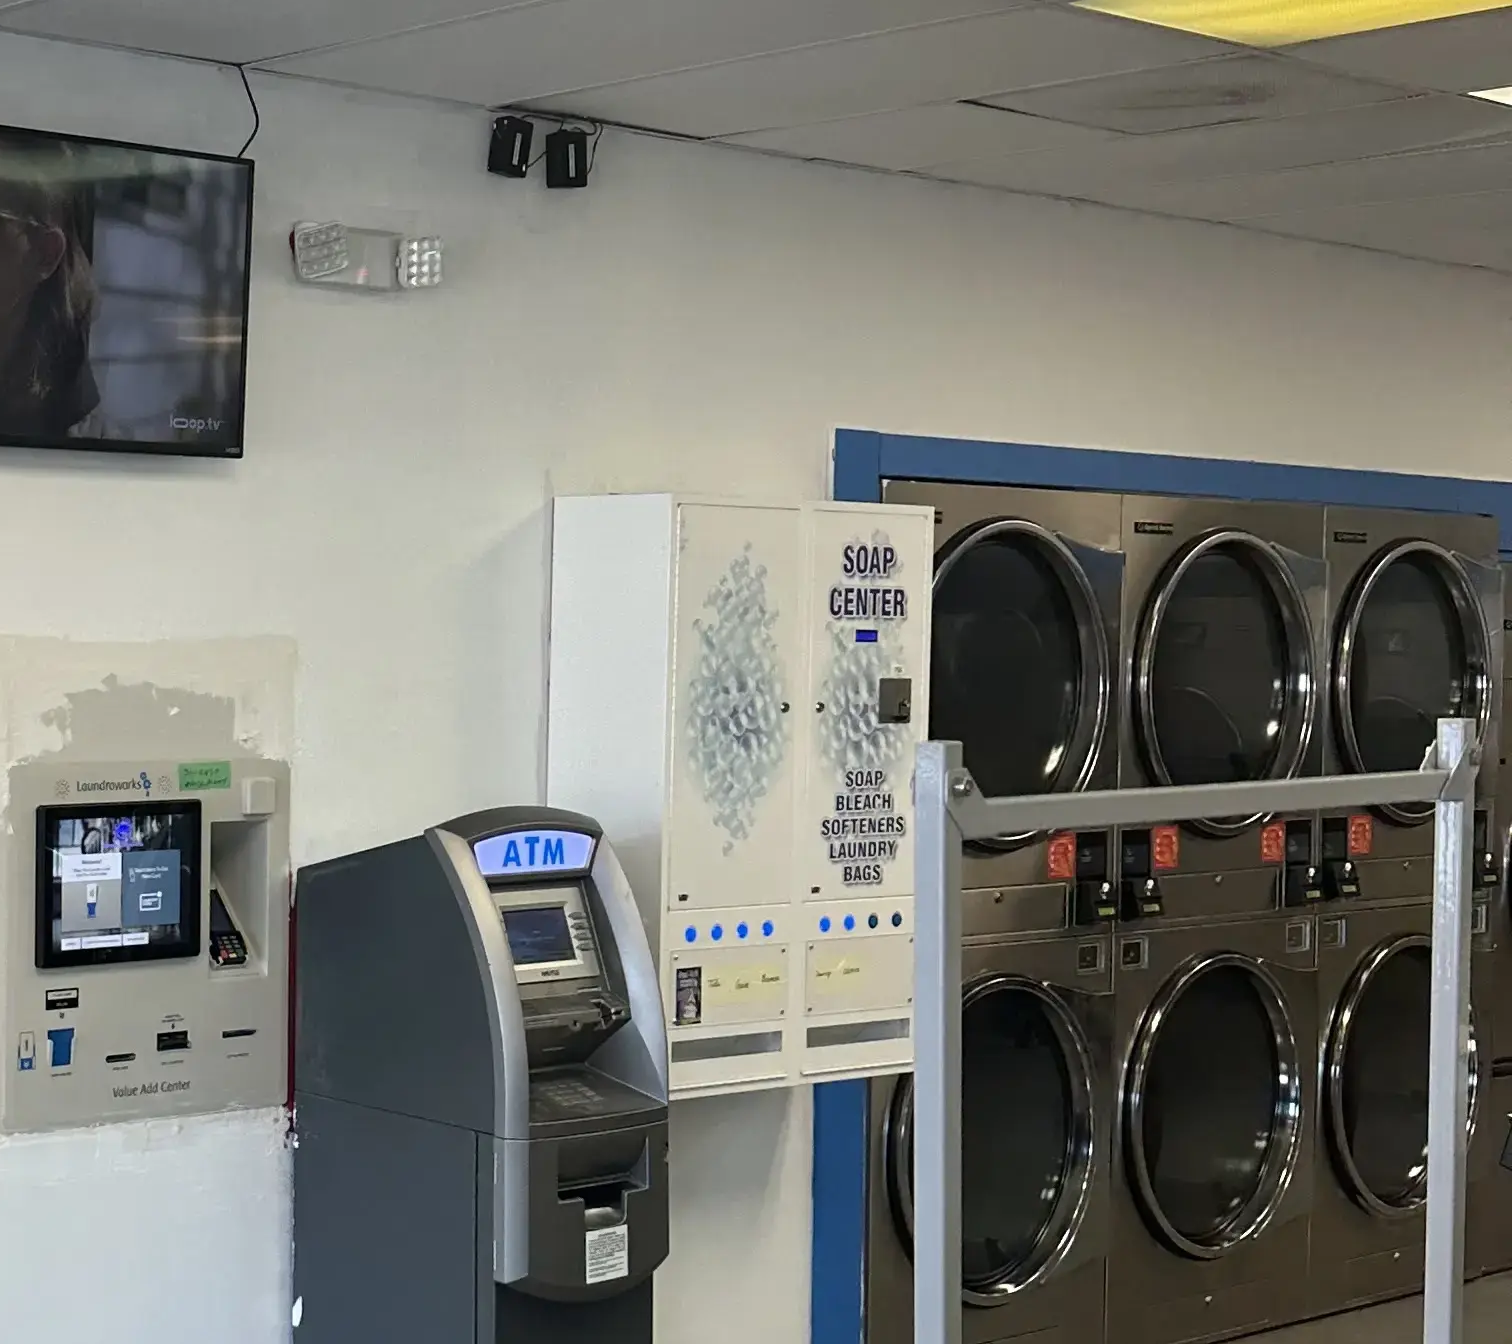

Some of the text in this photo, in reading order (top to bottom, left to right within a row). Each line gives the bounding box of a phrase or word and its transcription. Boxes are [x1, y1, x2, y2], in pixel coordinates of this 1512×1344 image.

[843, 545, 895, 575] SOAP
[830, 587, 905, 617] CENTER
[76, 778, 141, 792] Laundroworks
[845, 770, 883, 787] SOAP
[835, 793, 892, 811] BLEACH
[821, 816, 905, 836] SOFTENERS
[502, 836, 565, 867] ATM
[829, 840, 896, 859] LAUNDRY
[843, 864, 881, 882] BAGS
[112, 1080, 191, 1098] Value Add Center
